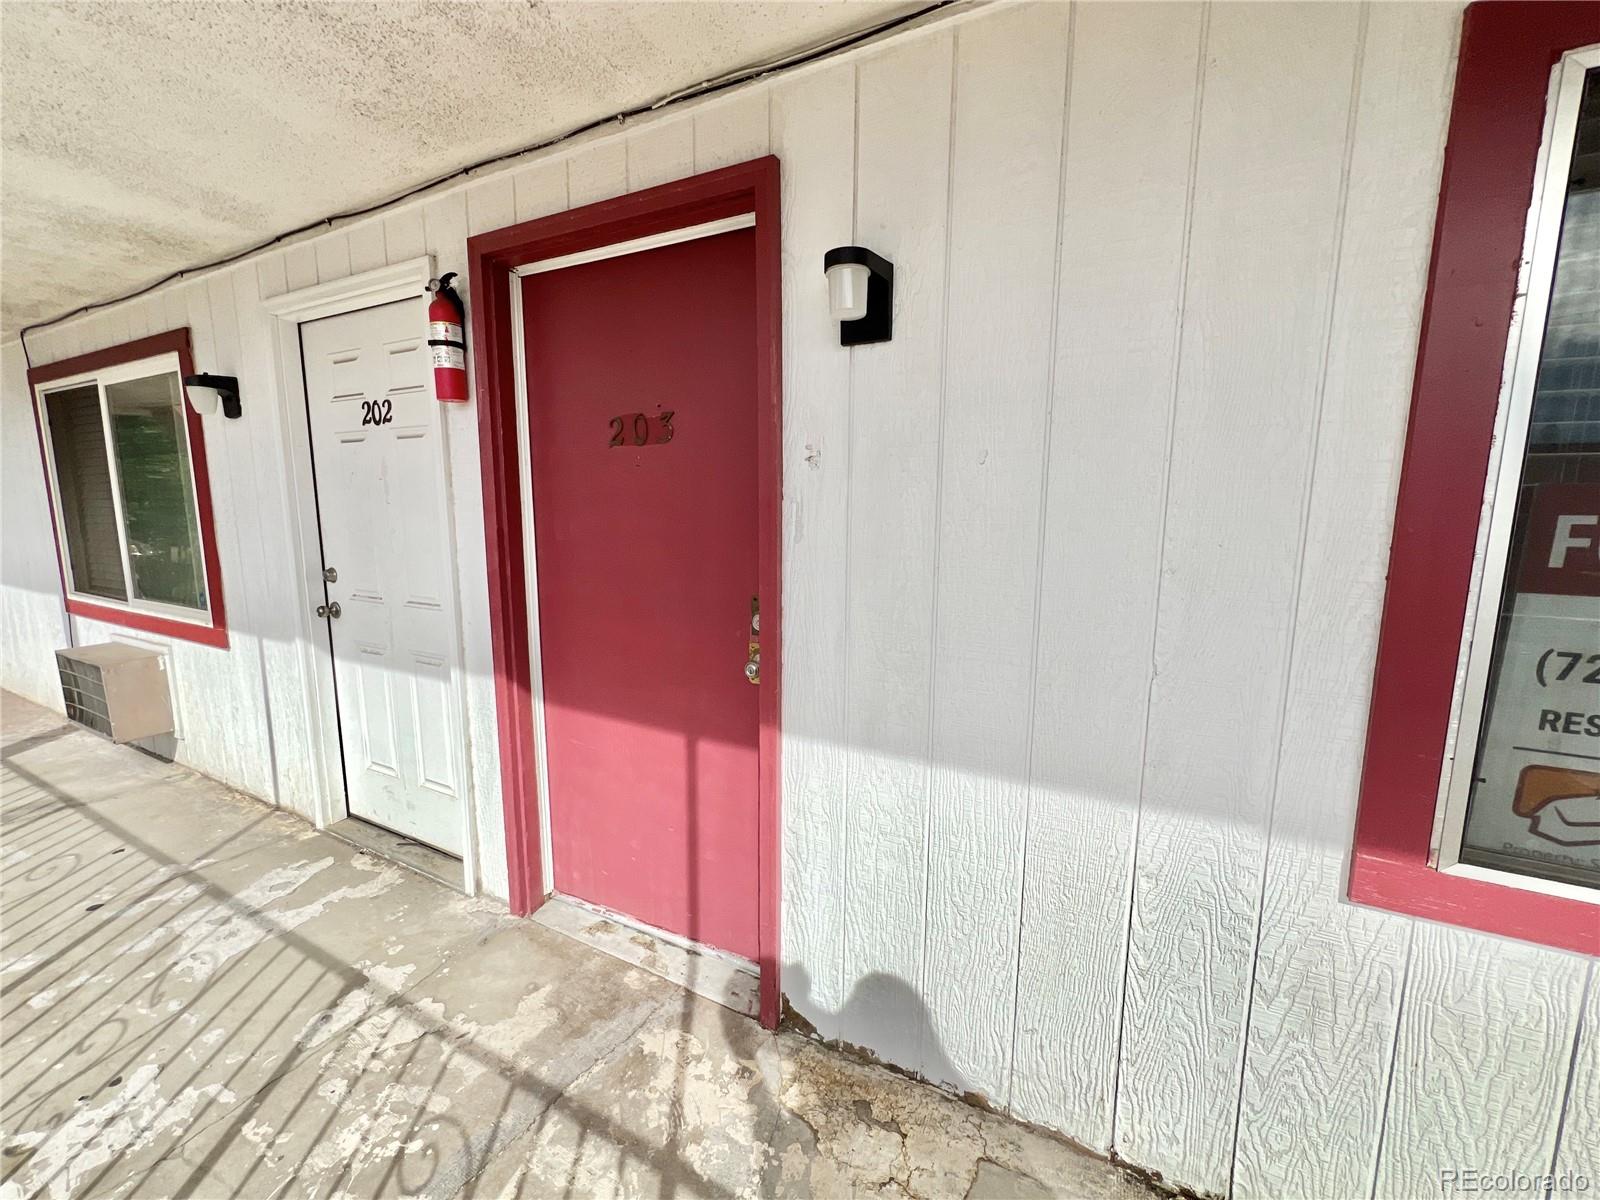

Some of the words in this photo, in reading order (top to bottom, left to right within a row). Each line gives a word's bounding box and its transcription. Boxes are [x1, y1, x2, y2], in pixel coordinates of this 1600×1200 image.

[361, 399, 392, 426] 202
[608, 411, 675, 448] 203
[1548, 514, 1600, 568] F
[1538, 709, 1600, 737] RES
